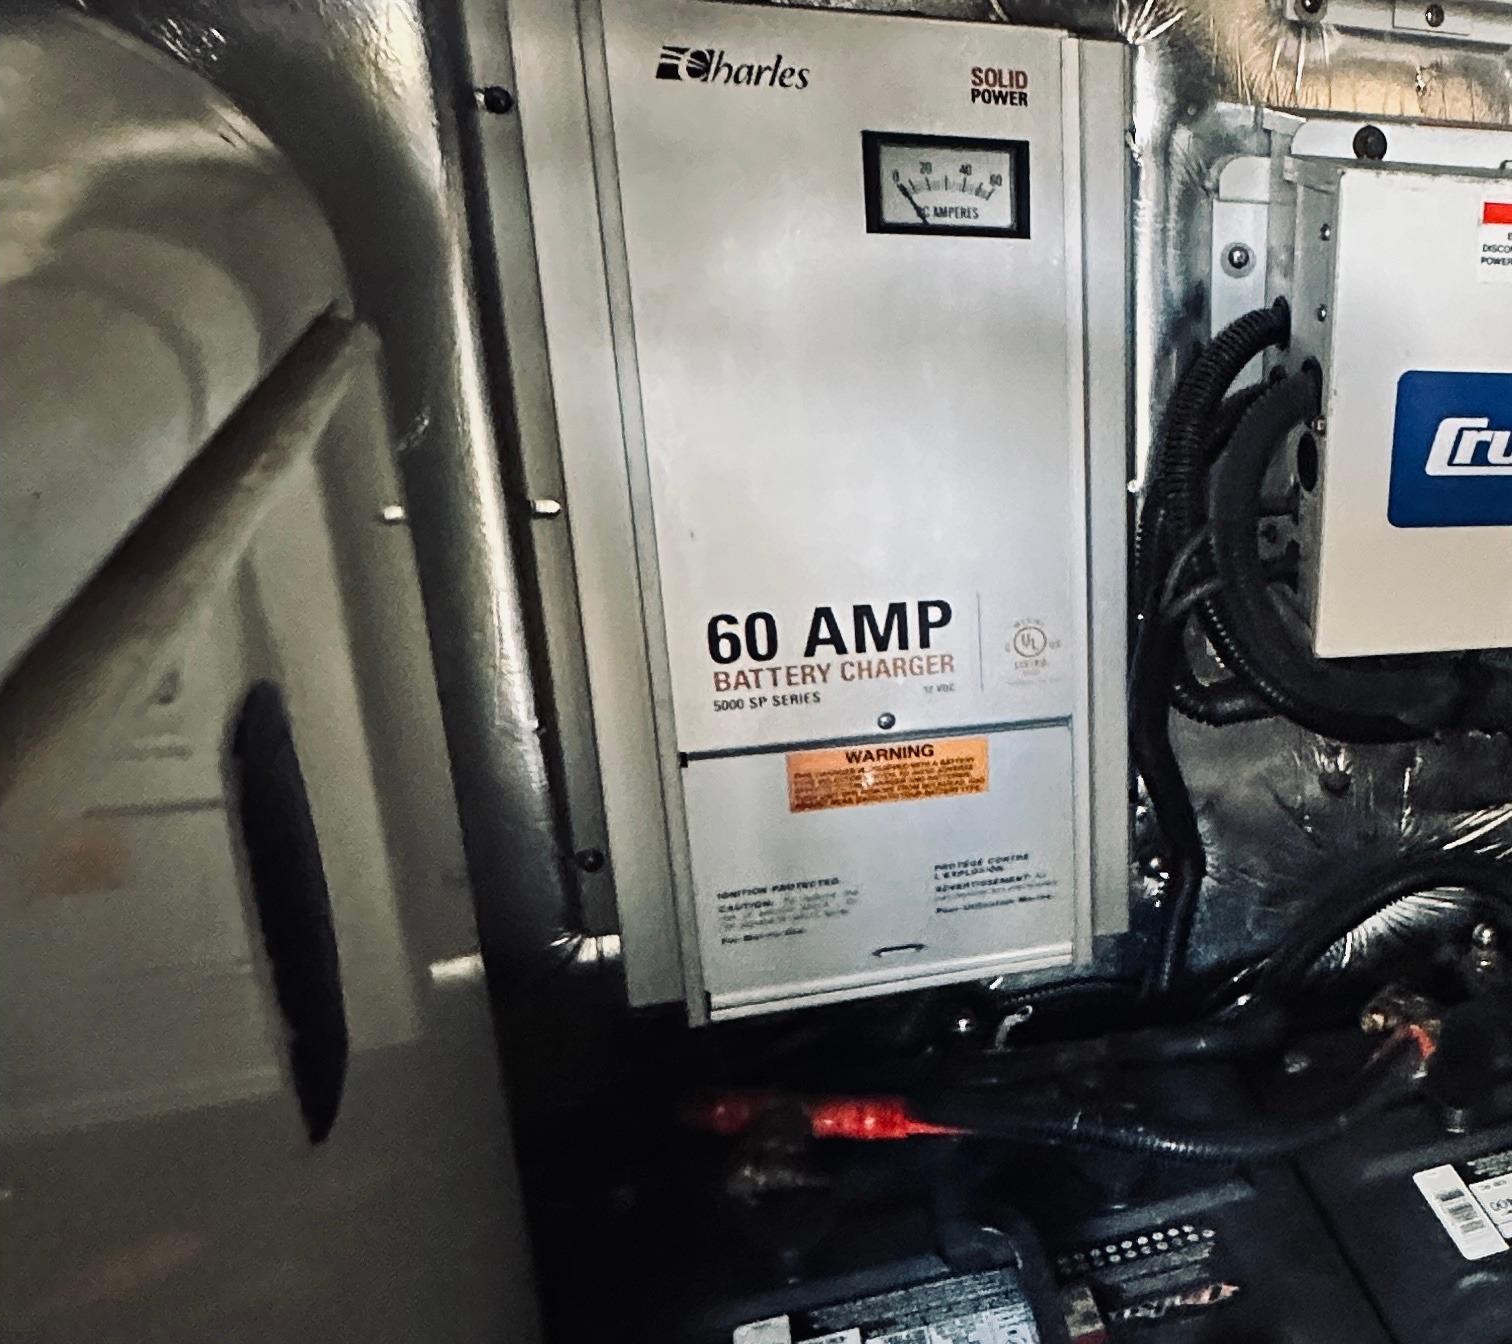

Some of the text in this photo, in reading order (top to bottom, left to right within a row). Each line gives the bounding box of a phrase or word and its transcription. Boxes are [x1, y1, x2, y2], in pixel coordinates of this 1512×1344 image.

[685, 48, 810, 90] Charles
[971, 67, 1028, 89] SOLID
[971, 88, 1028, 106] POWER
[892, 161, 1002, 187] 0 20 40 60
[933, 206, 979, 219] AMPERES
[1481, 257, 1512, 265] POWER
[707, 600, 953, 664] 60 AMP
[713, 654, 955, 692] BATTERY CHARGER
[713, 691, 821, 712] 5000 SP SERIES
[845, 743, 934, 764] WARNING
[717, 877, 839, 899] IGNITION PROTECTED
